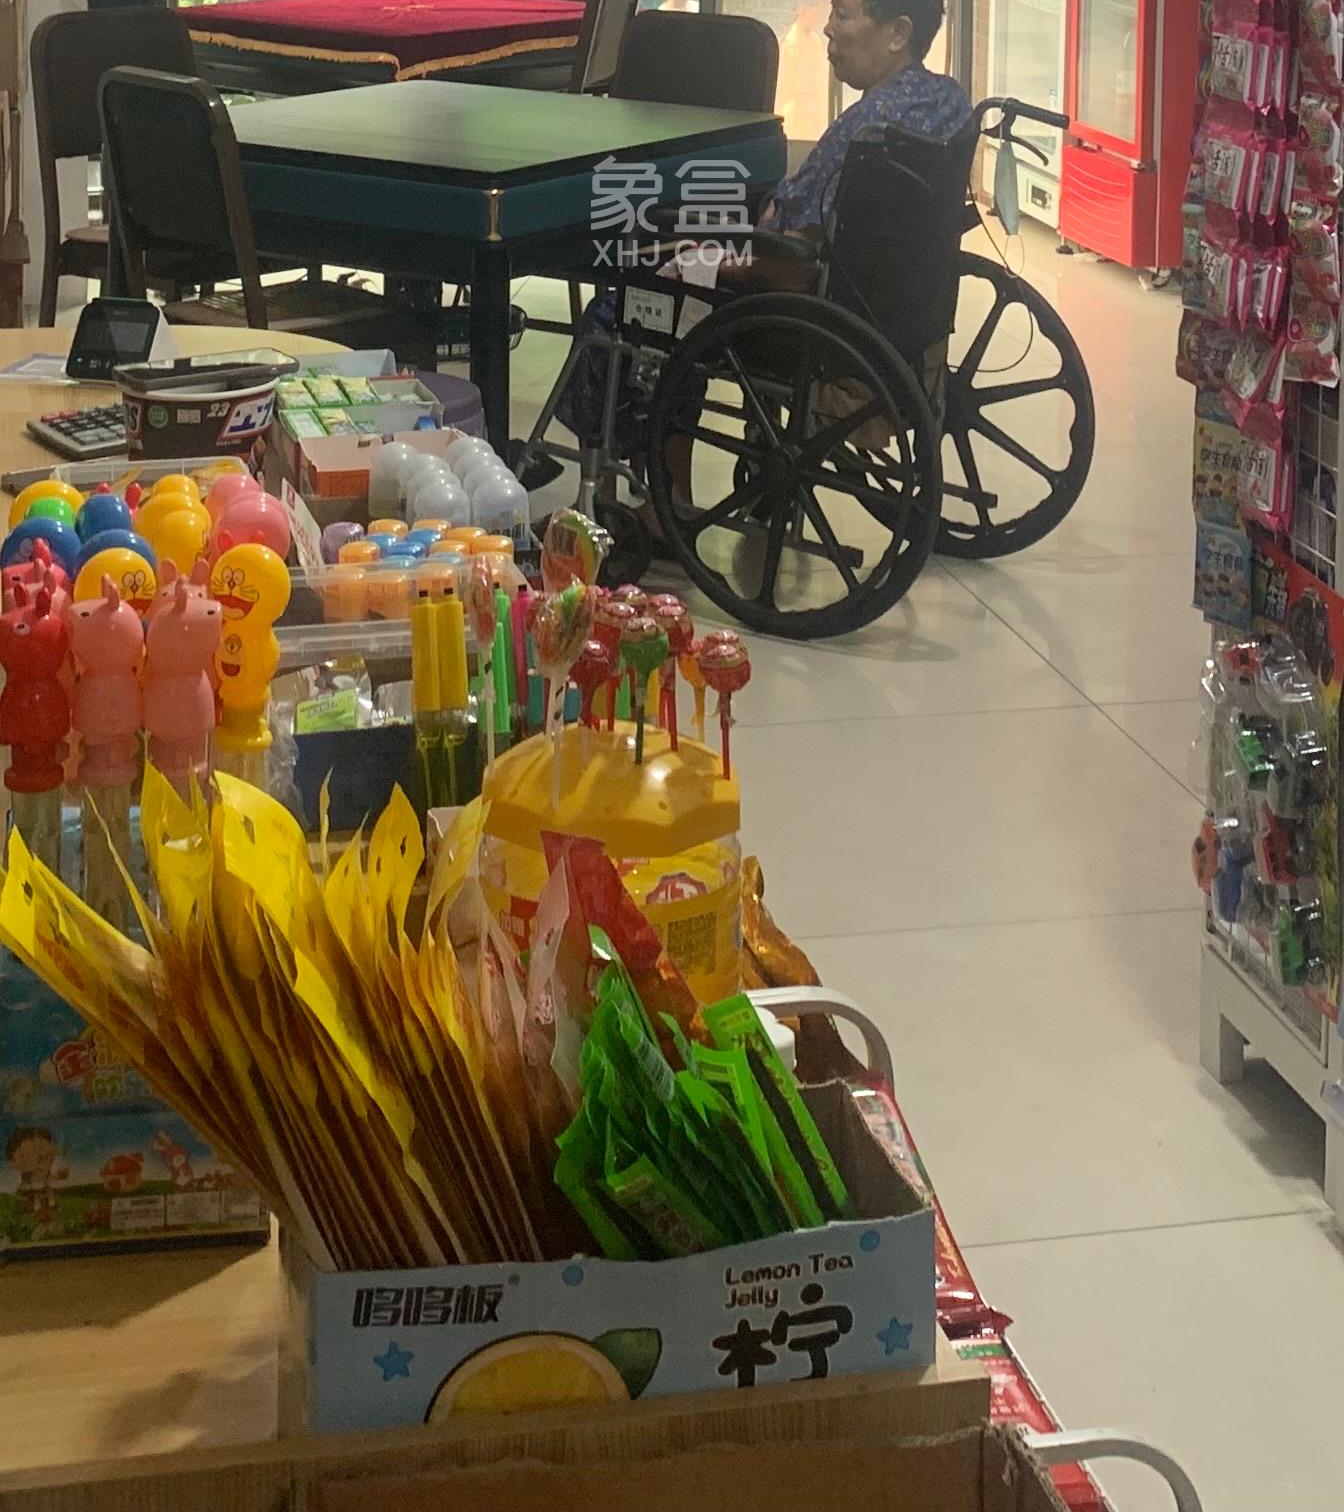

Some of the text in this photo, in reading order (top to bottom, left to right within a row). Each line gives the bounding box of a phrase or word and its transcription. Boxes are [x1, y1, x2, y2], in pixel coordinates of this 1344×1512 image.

[725, 1253, 853, 1285] Lemon Tea
[724, 1286, 778, 1308] Jelly
